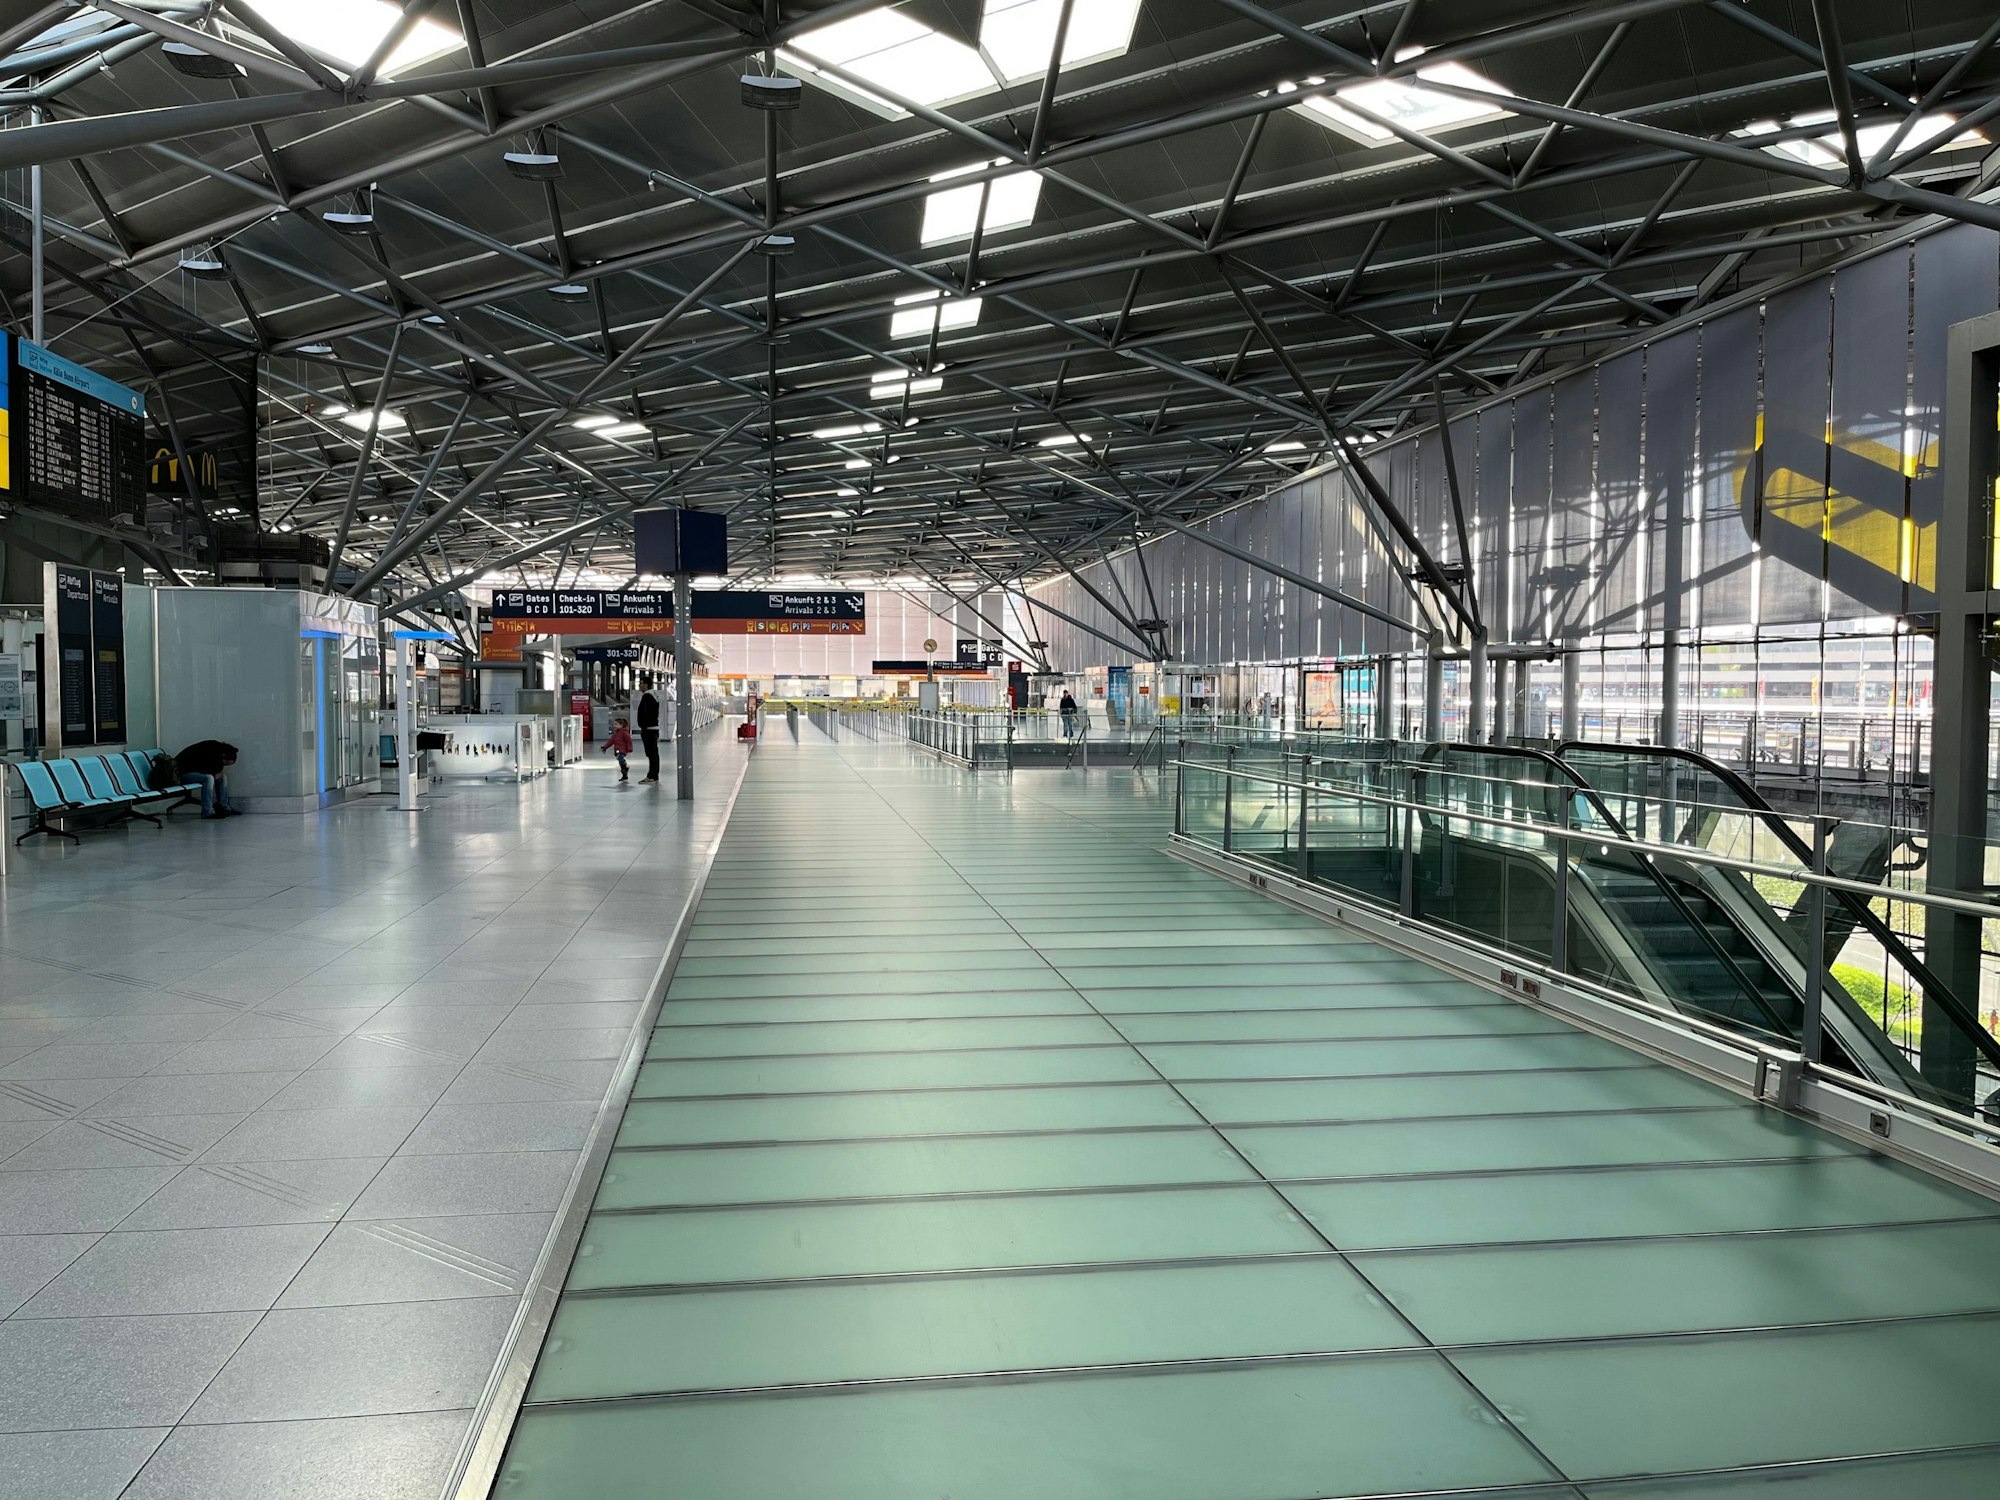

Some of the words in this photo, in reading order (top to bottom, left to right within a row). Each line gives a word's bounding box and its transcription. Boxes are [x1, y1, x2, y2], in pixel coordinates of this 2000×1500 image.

[64, 370, 74, 382] Bonn
[74, 375, 90, 389] Airport
[67, 575, 81, 588] Abflug
[103, 581, 118, 592] Ankunft
[67, 588, 89, 601] Departures
[103, 594, 118, 604] Arrivals
[526, 595, 550, 603] Gates
[559, 595, 595, 603] Check-in
[623, 595, 655, 603] Ankunft
[658, 595, 662, 603] 1
